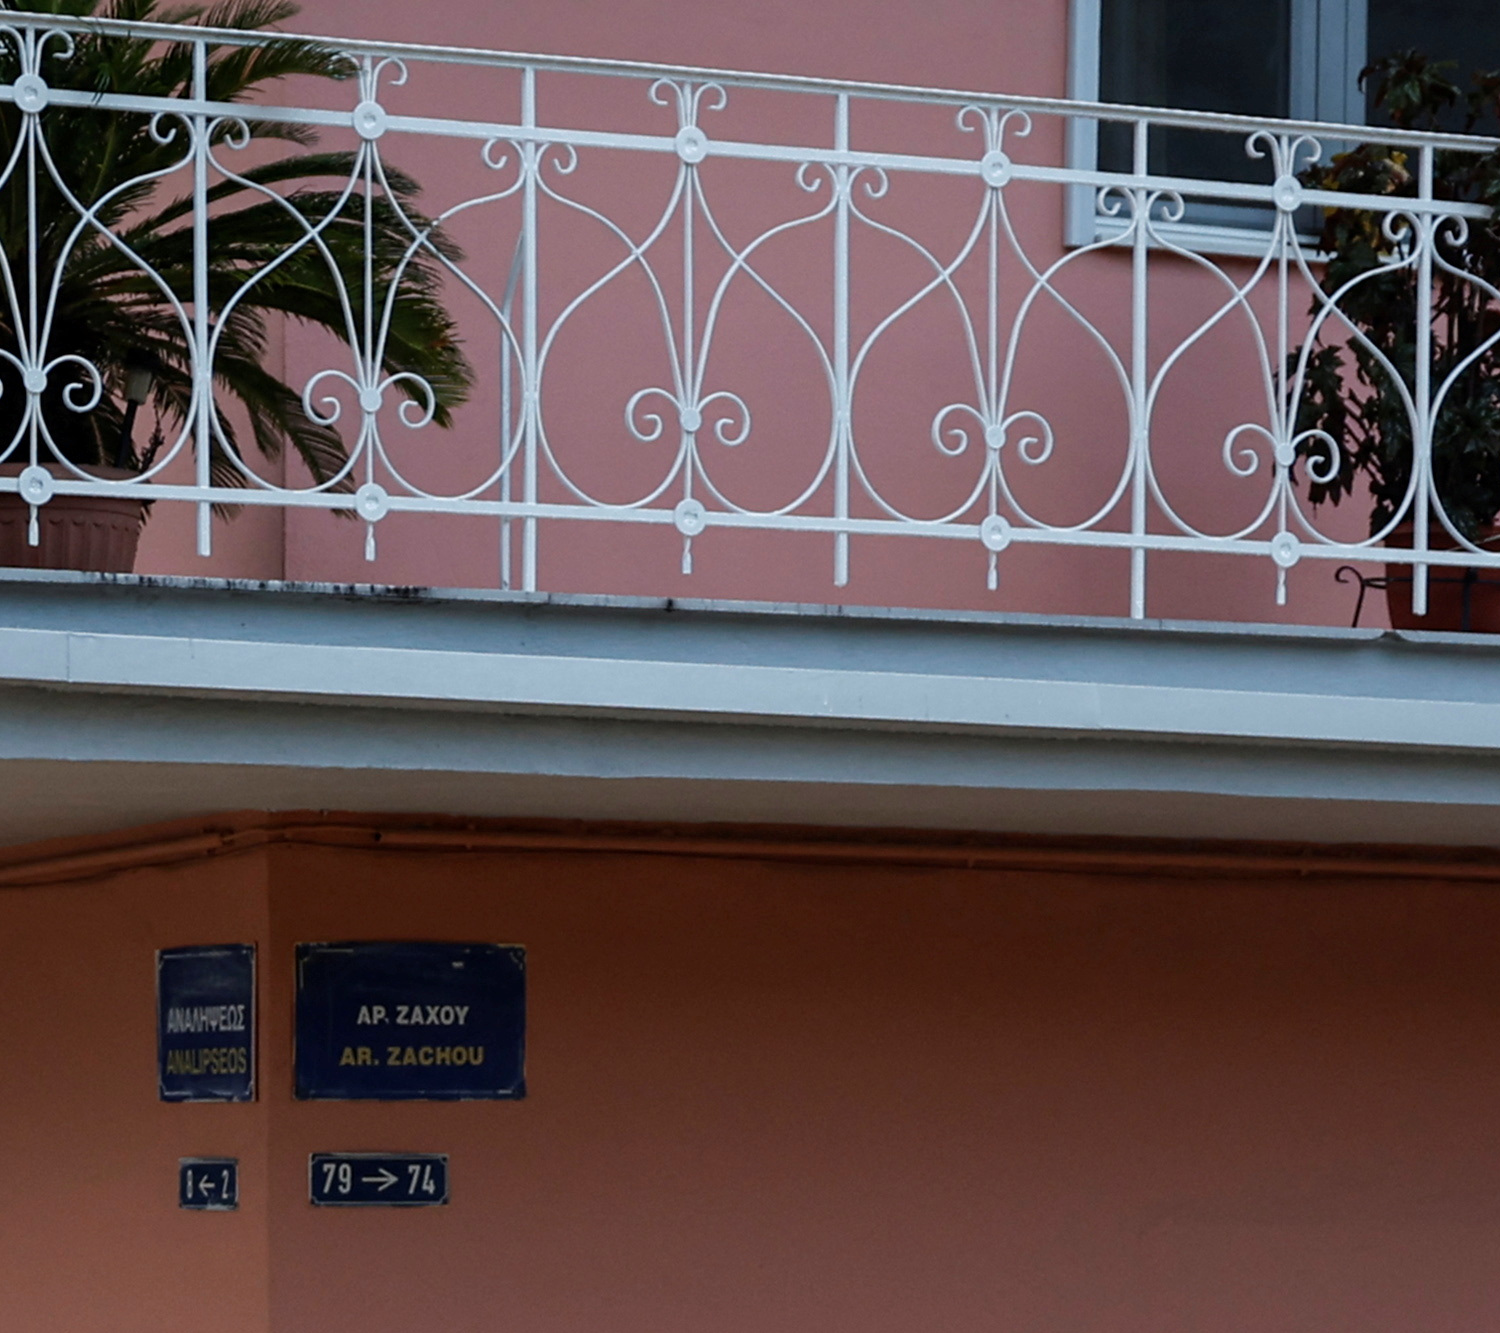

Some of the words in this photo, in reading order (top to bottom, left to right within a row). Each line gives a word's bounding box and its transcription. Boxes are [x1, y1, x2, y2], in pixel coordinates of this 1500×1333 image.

[166, 1004, 246, 1034] ΑΝΑΛΗΨΕΩΣ
[356, 1005, 389, 1026] ΑΡ.
[395, 1005, 470, 1026] ΖΑΧΟΥ
[166, 1046, 247, 1076] ANALIPSEOS
[339, 1046, 380, 1067] AR.
[386, 1046, 485, 1067] ZACHOU
[186, 1168, 194, 1200] 8
[221, 1168, 230, 1200] 2
[322, 1163, 352, 1195] 79
[408, 1164, 436, 1195] 74
